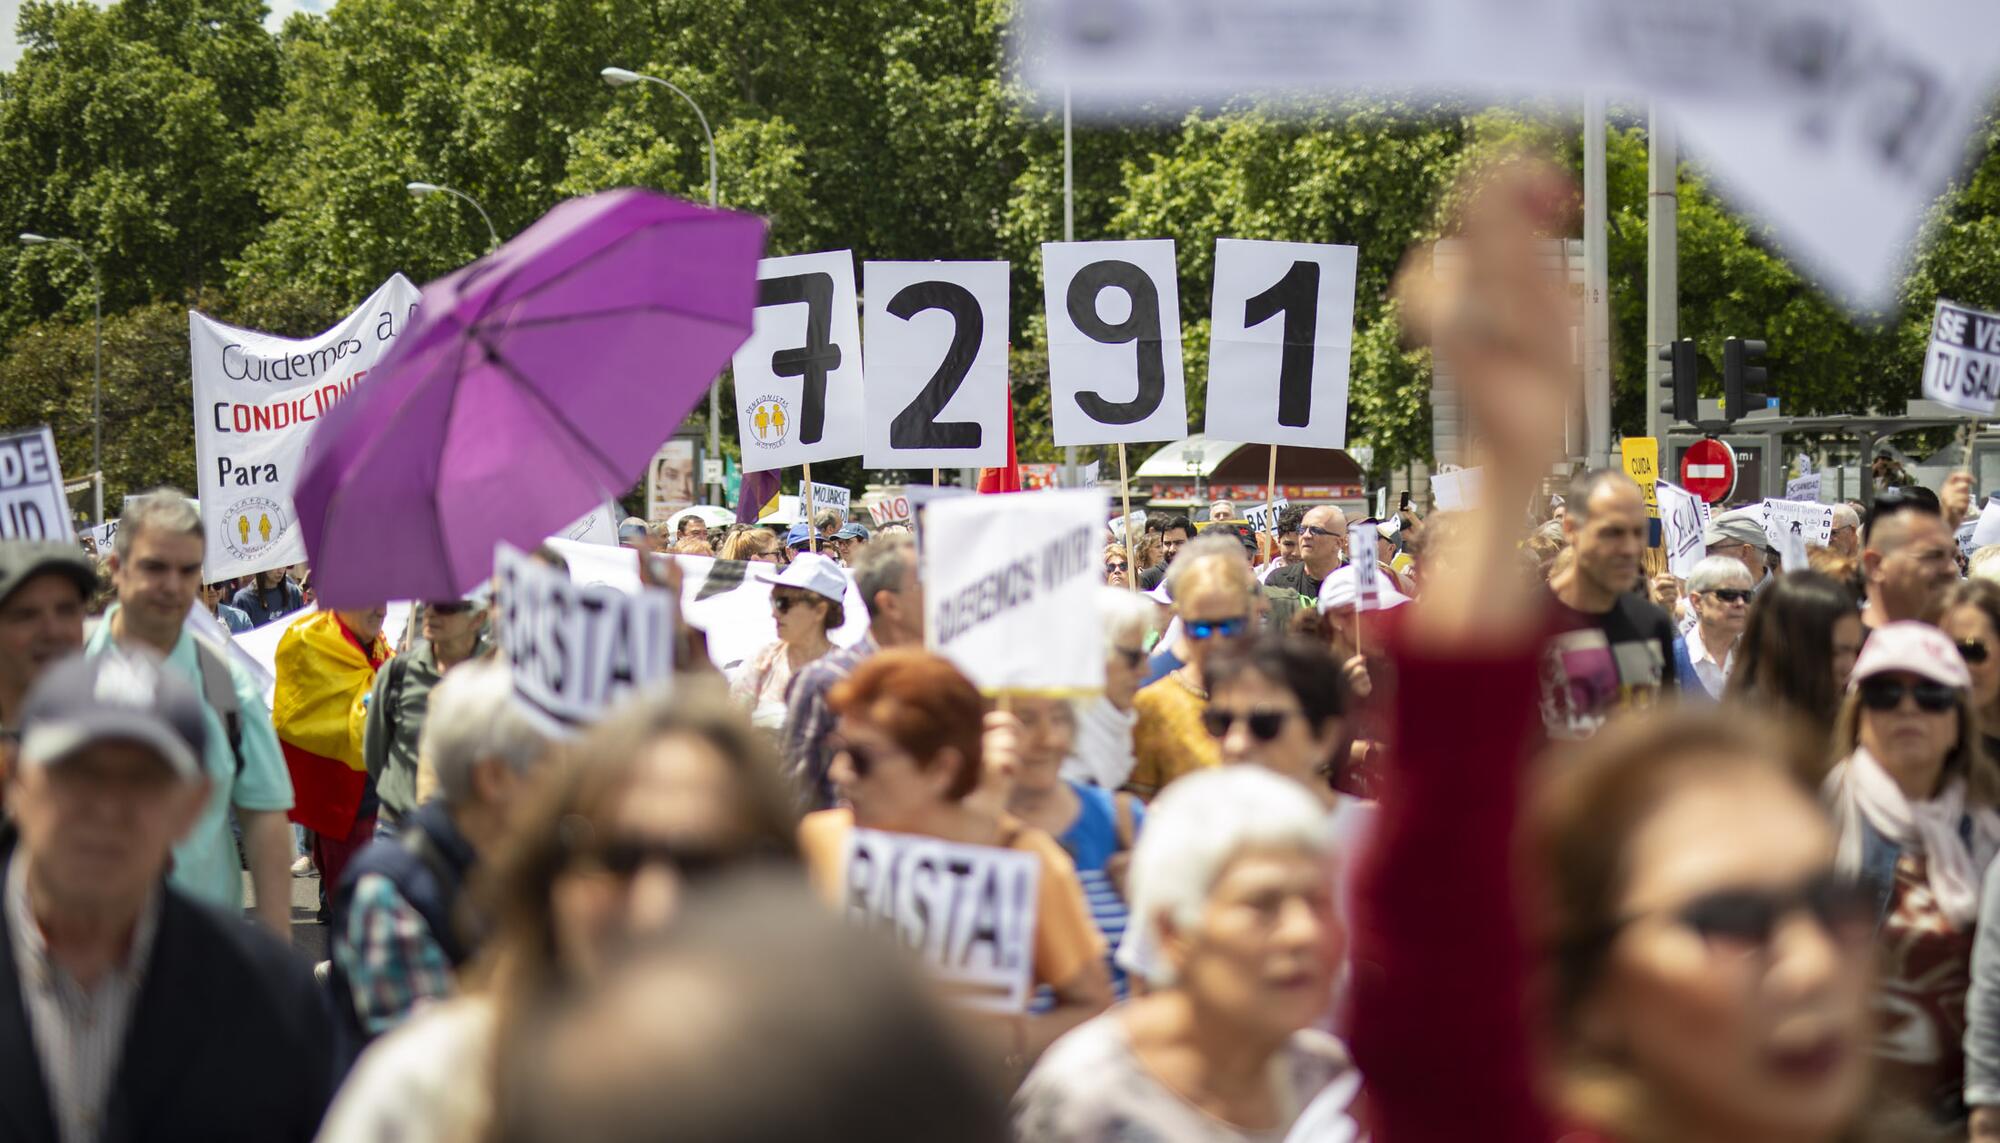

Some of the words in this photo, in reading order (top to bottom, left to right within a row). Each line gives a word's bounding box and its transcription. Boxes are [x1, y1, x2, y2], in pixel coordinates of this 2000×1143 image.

[222, 338, 362, 383] Cuidemos
[376, 311, 397, 341] a
[1066, 259, 1165, 425] 9
[1244, 260, 1320, 427] 1
[1937, 309, 1969, 344] SE
[755, 271, 841, 445] 7
[885, 280, 984, 449] 2
[1934, 351, 1961, 391] TU
[217, 456, 279, 487] Para
[1631, 457, 1652, 475] CUIDA
[813, 486, 847, 507] MOJARSE
